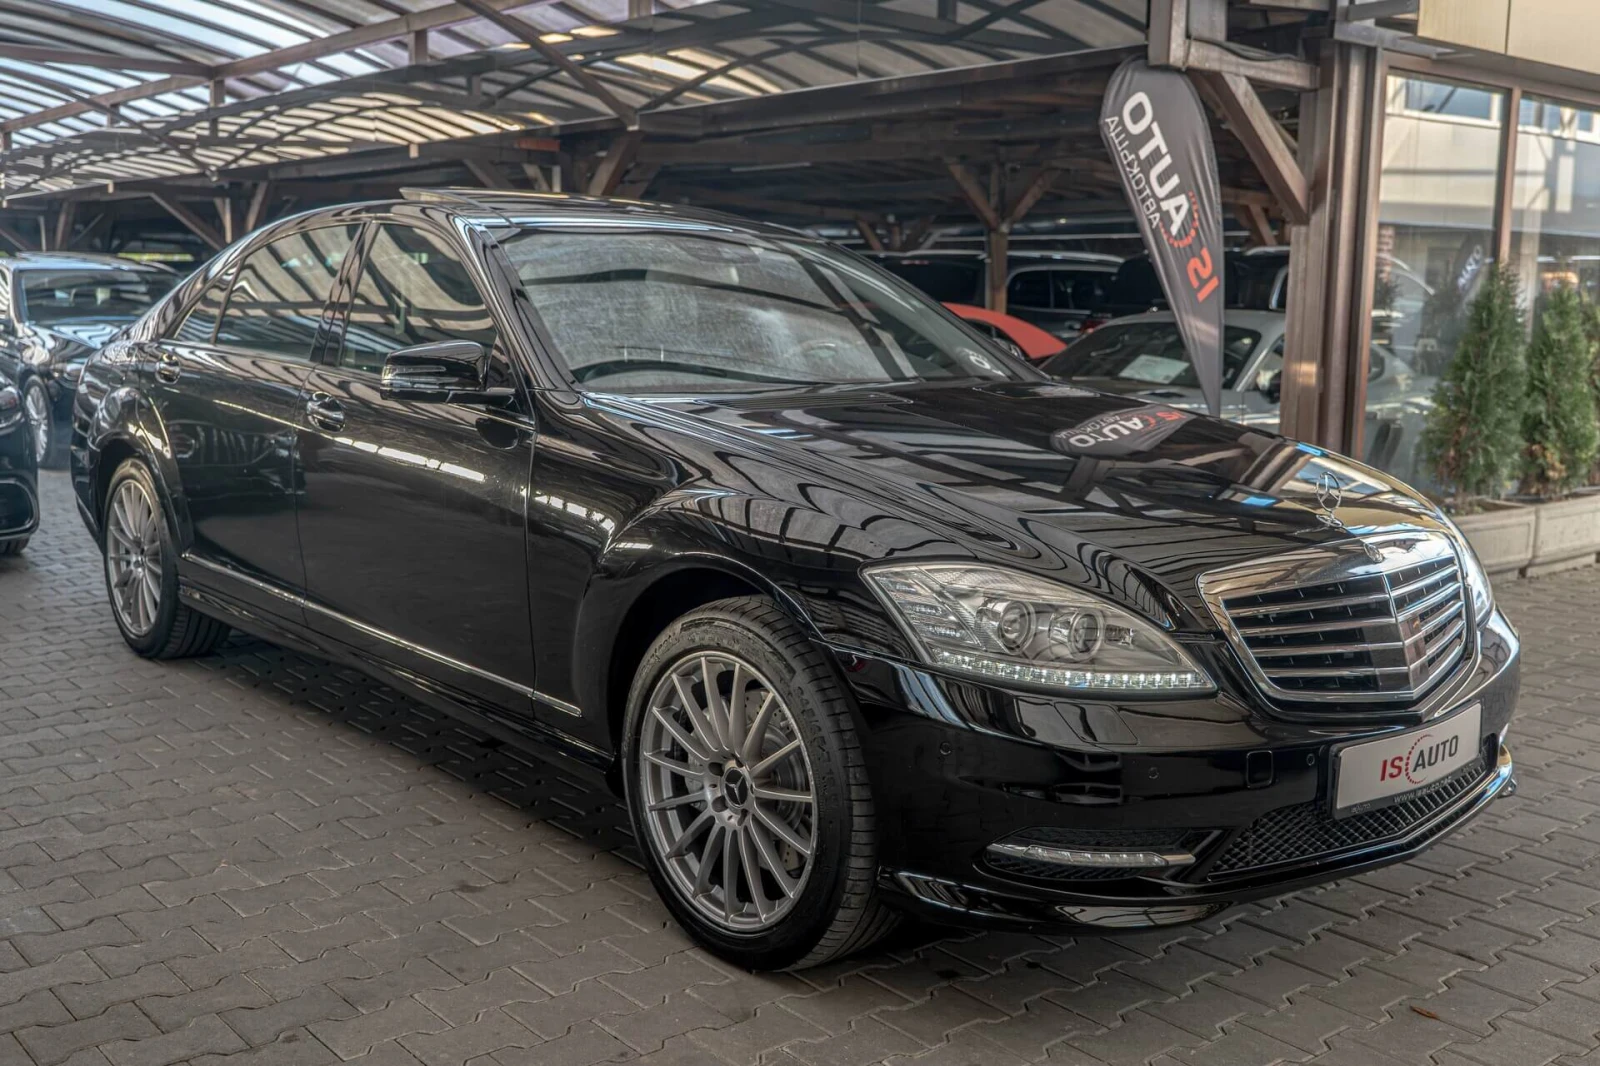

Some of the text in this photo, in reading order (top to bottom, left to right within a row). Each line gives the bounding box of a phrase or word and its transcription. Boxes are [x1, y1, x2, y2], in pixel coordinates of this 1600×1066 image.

[1069, 416, 1144, 447] AUTO
[1380, 735, 1459, 781] IS AUTO
